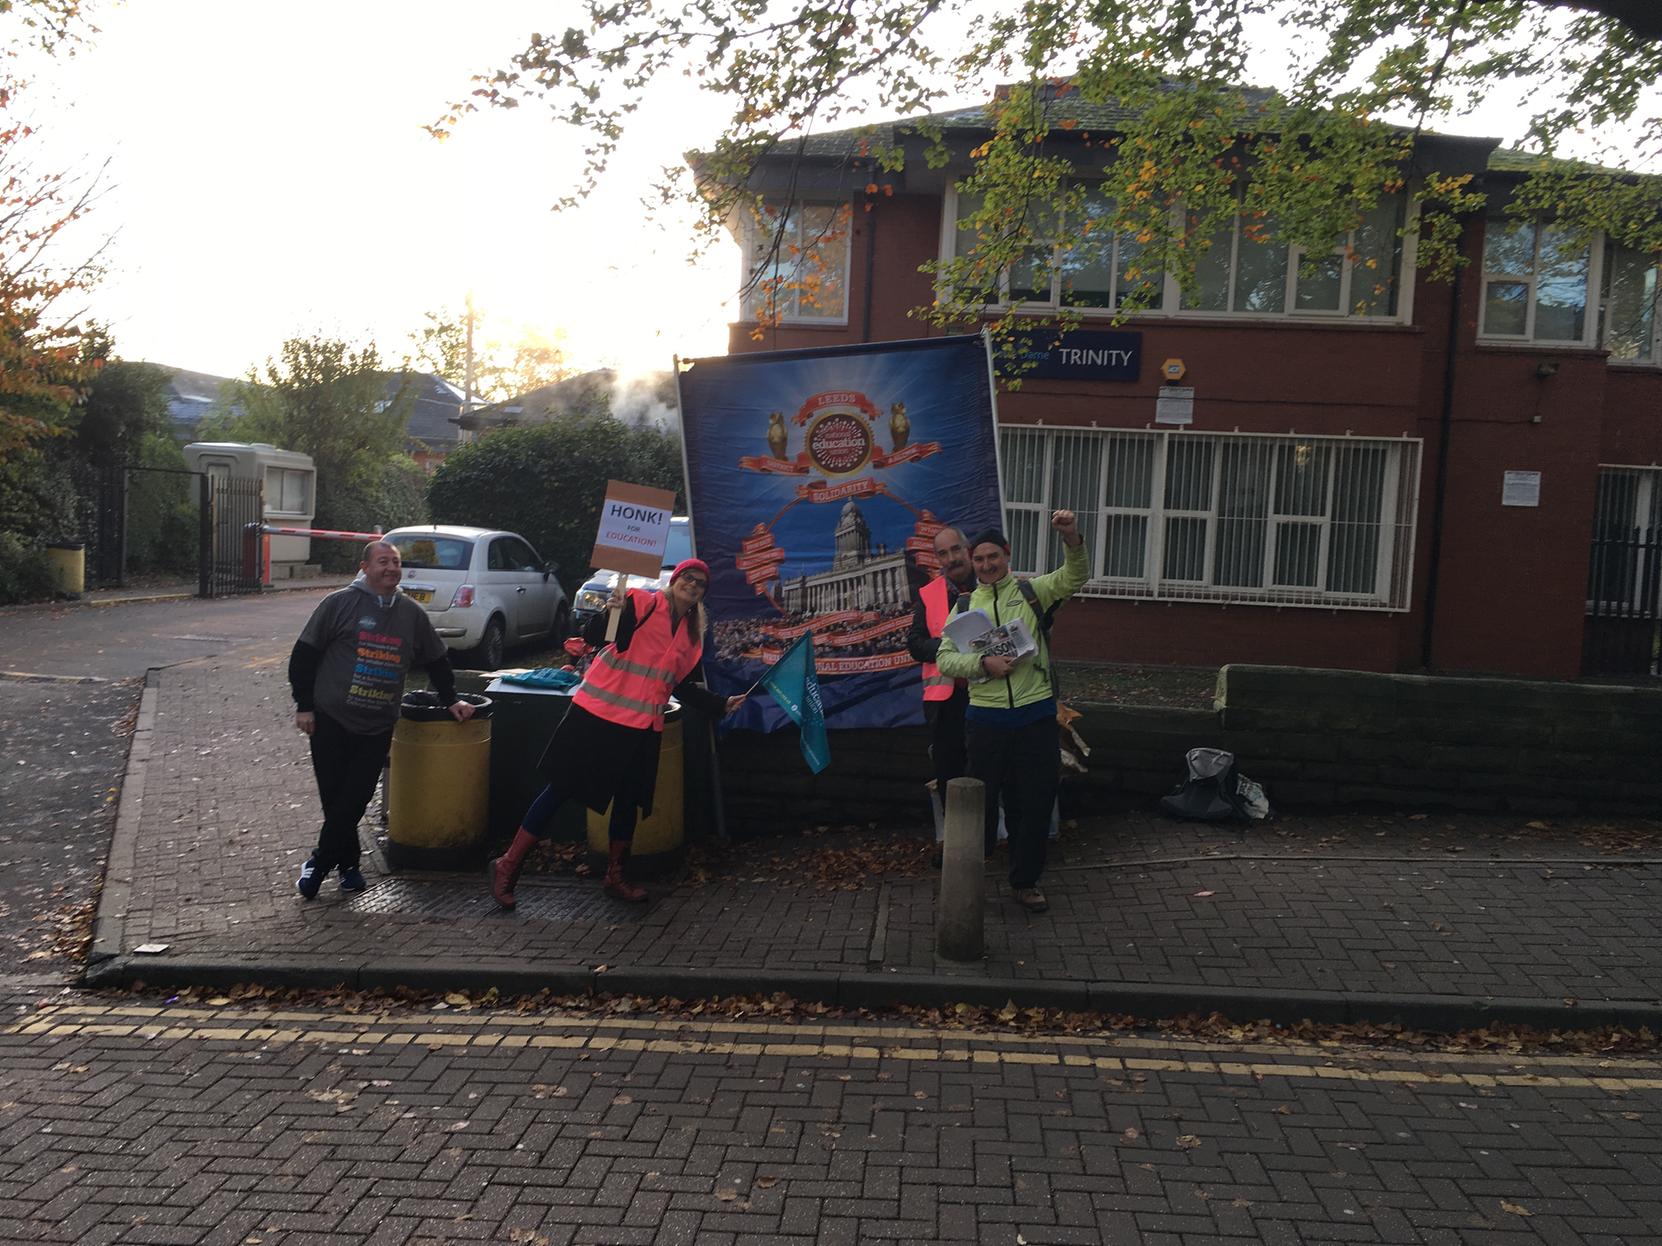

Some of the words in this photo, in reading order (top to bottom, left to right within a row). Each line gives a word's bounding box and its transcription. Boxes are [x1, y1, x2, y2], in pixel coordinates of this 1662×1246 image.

[1059, 348, 1133, 367] TRINITY
[817, 393, 857, 406] LEEDS
[812, 437, 866, 450] education
[811, 480, 870, 503] SOLIDARITY
[610, 504, 663, 526] HONK!
[627, 524, 642, 532] FOR
[606, 530, 658, 548] EDUCATION!
[839, 656, 892, 671] EDUCATION
